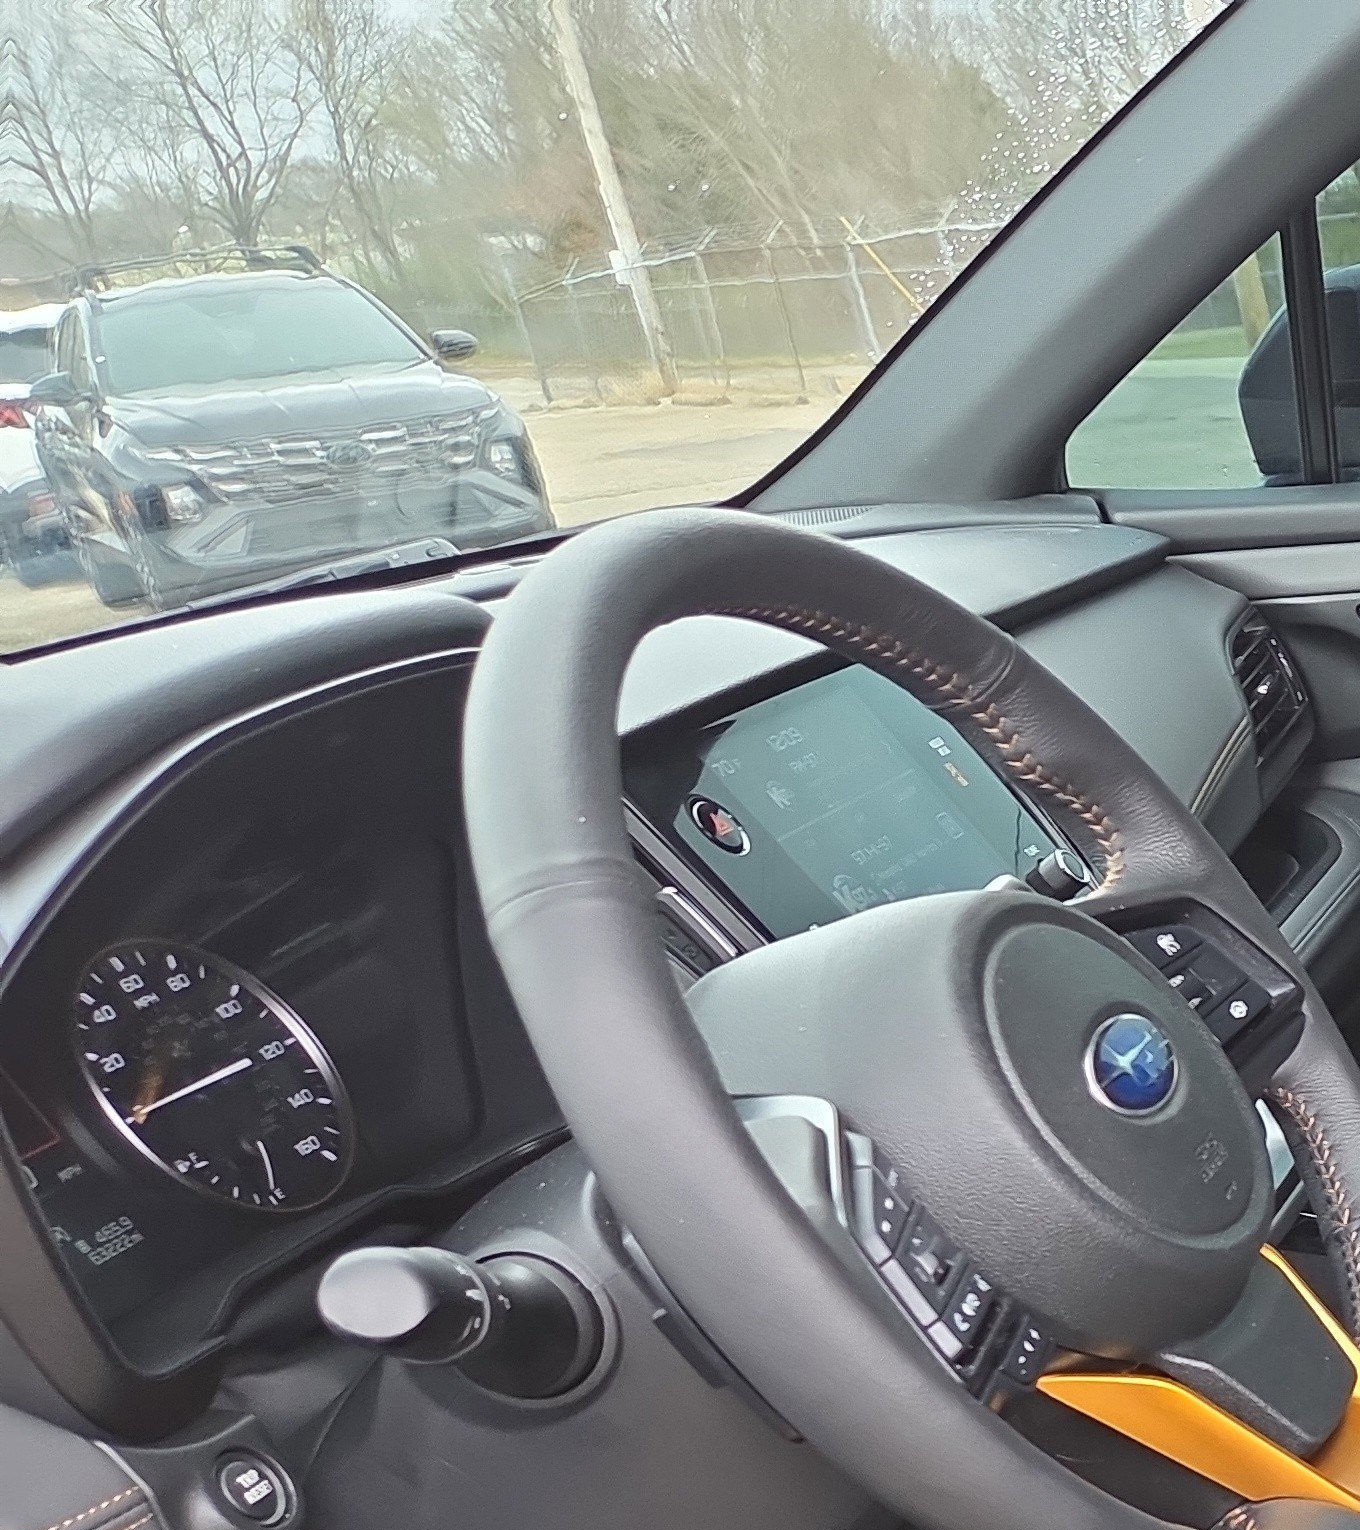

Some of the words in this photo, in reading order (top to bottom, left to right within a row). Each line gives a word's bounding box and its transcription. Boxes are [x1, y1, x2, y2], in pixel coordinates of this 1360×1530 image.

[119, 974, 144, 992] 60
[166, 973, 190, 992] 80
[93, 1005, 116, 1022] 40
[215, 1000, 242, 1019] 100
[259, 1041, 285, 1060] 120
[100, 1053, 125, 1072] 20
[287, 1089, 314, 1108] 140
[293, 1136, 320, 1155] 160
